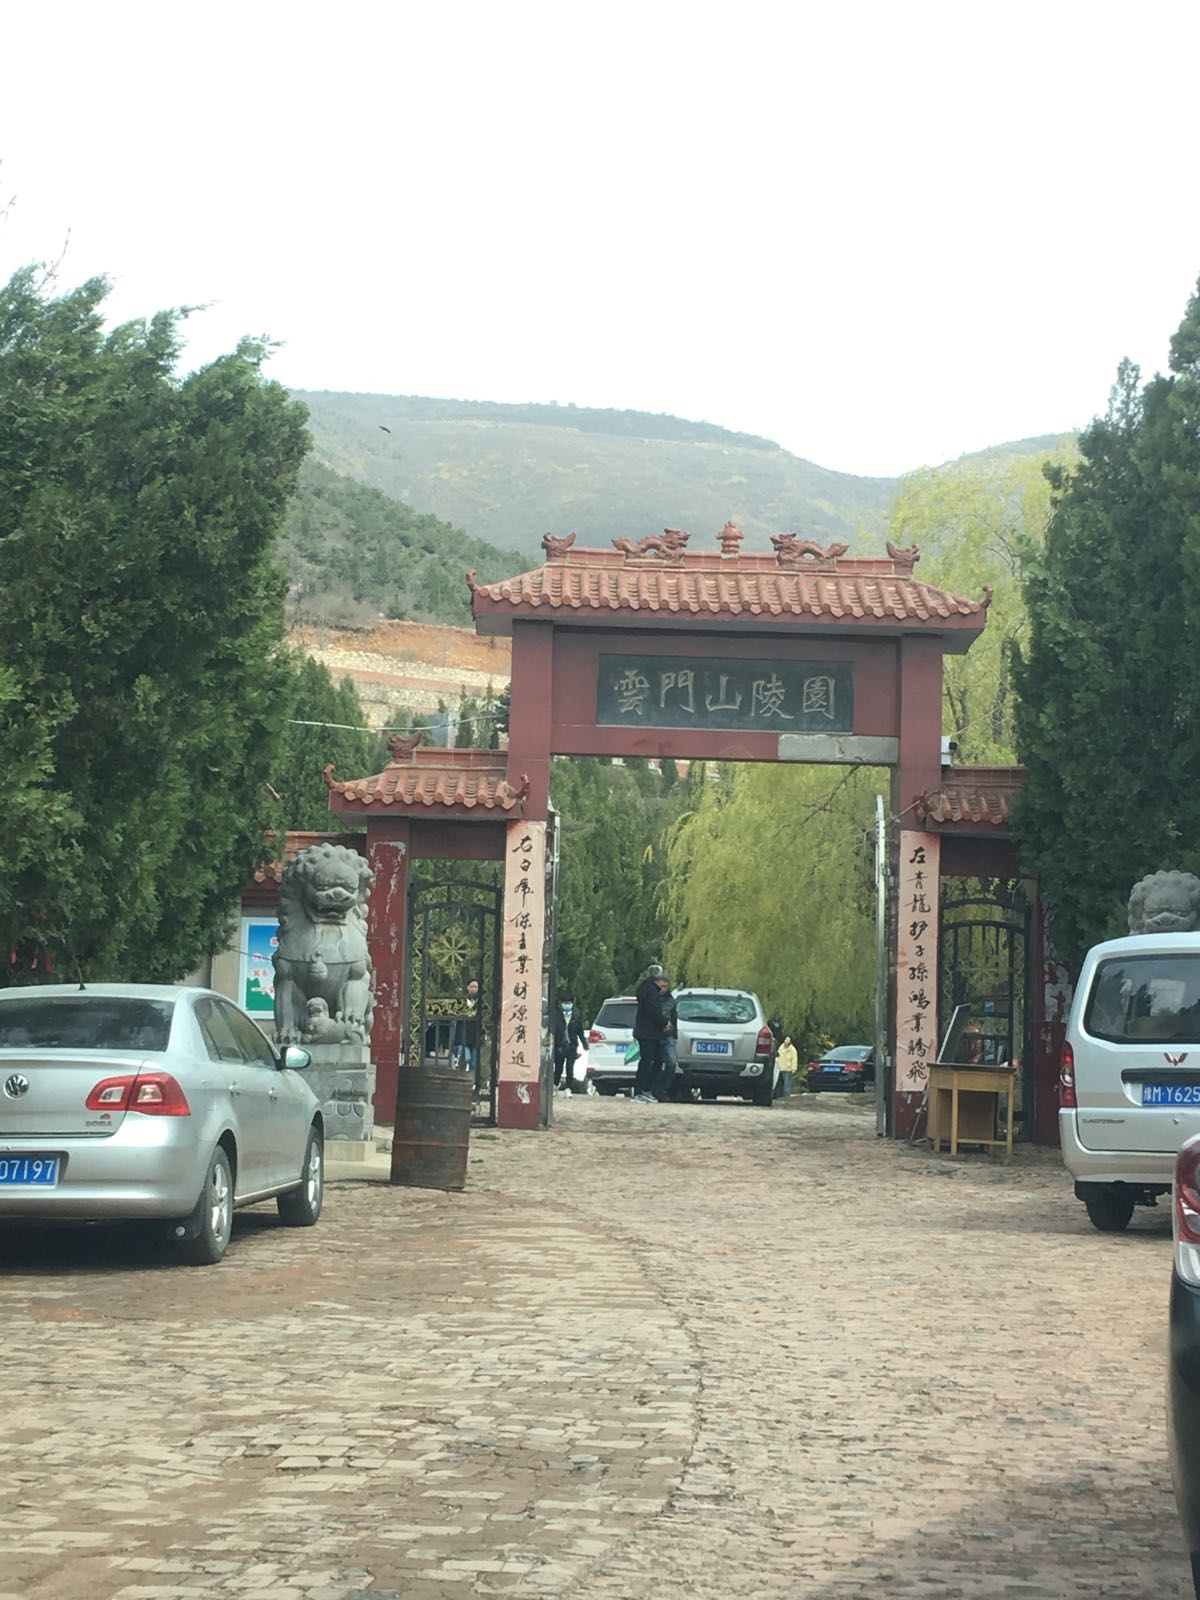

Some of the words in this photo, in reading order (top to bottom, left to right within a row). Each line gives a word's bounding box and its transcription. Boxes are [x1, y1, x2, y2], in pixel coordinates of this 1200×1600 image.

[613, 669, 836, 720] 雲門山陵園
